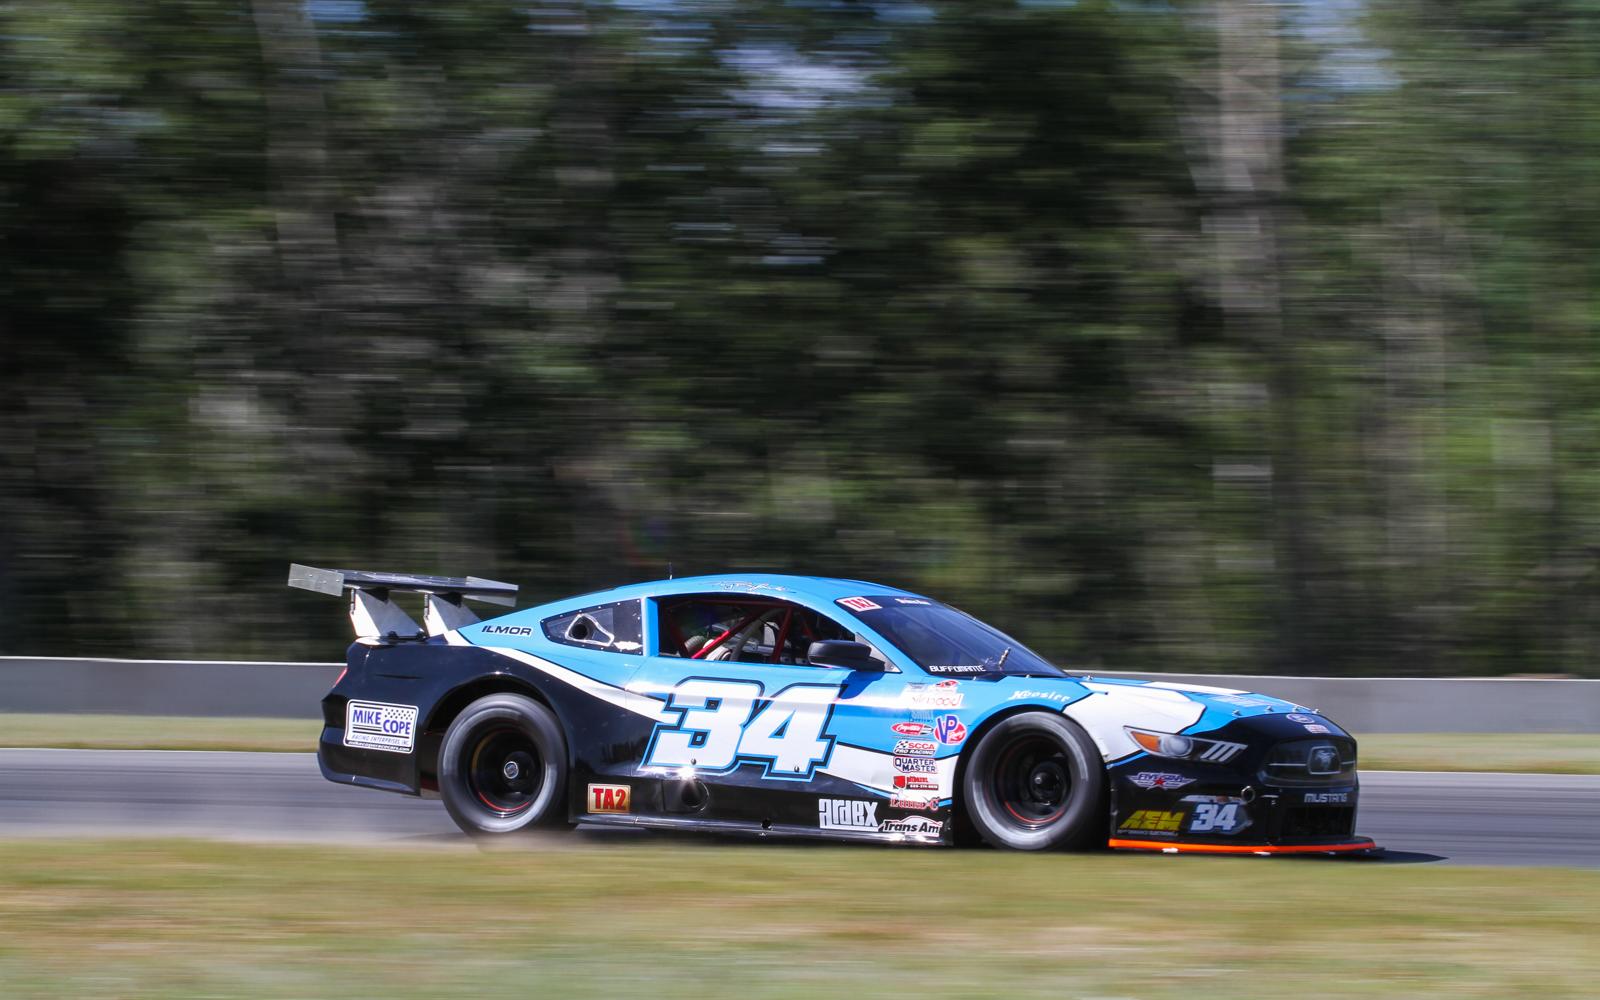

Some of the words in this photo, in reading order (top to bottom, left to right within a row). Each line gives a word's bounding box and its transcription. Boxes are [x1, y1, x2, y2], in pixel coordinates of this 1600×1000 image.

[481, 625, 532, 636] ILMOR
[1008, 690, 1071, 702] Hoosier
[352, 709, 382, 725] MIKE
[383, 719, 411, 735] COPE
[639, 677, 846, 781] 34
[937, 715, 958, 744] VP
[894, 757, 935, 767] QUARTER
[593, 787, 626, 810] TA2
[1303, 793, 1348, 803] MUSTANG
[1119, 810, 1185, 831] AEM
[1189, 803, 1238, 831] 34
[884, 821, 917, 832] Trans
[919, 822, 939, 834] Am
